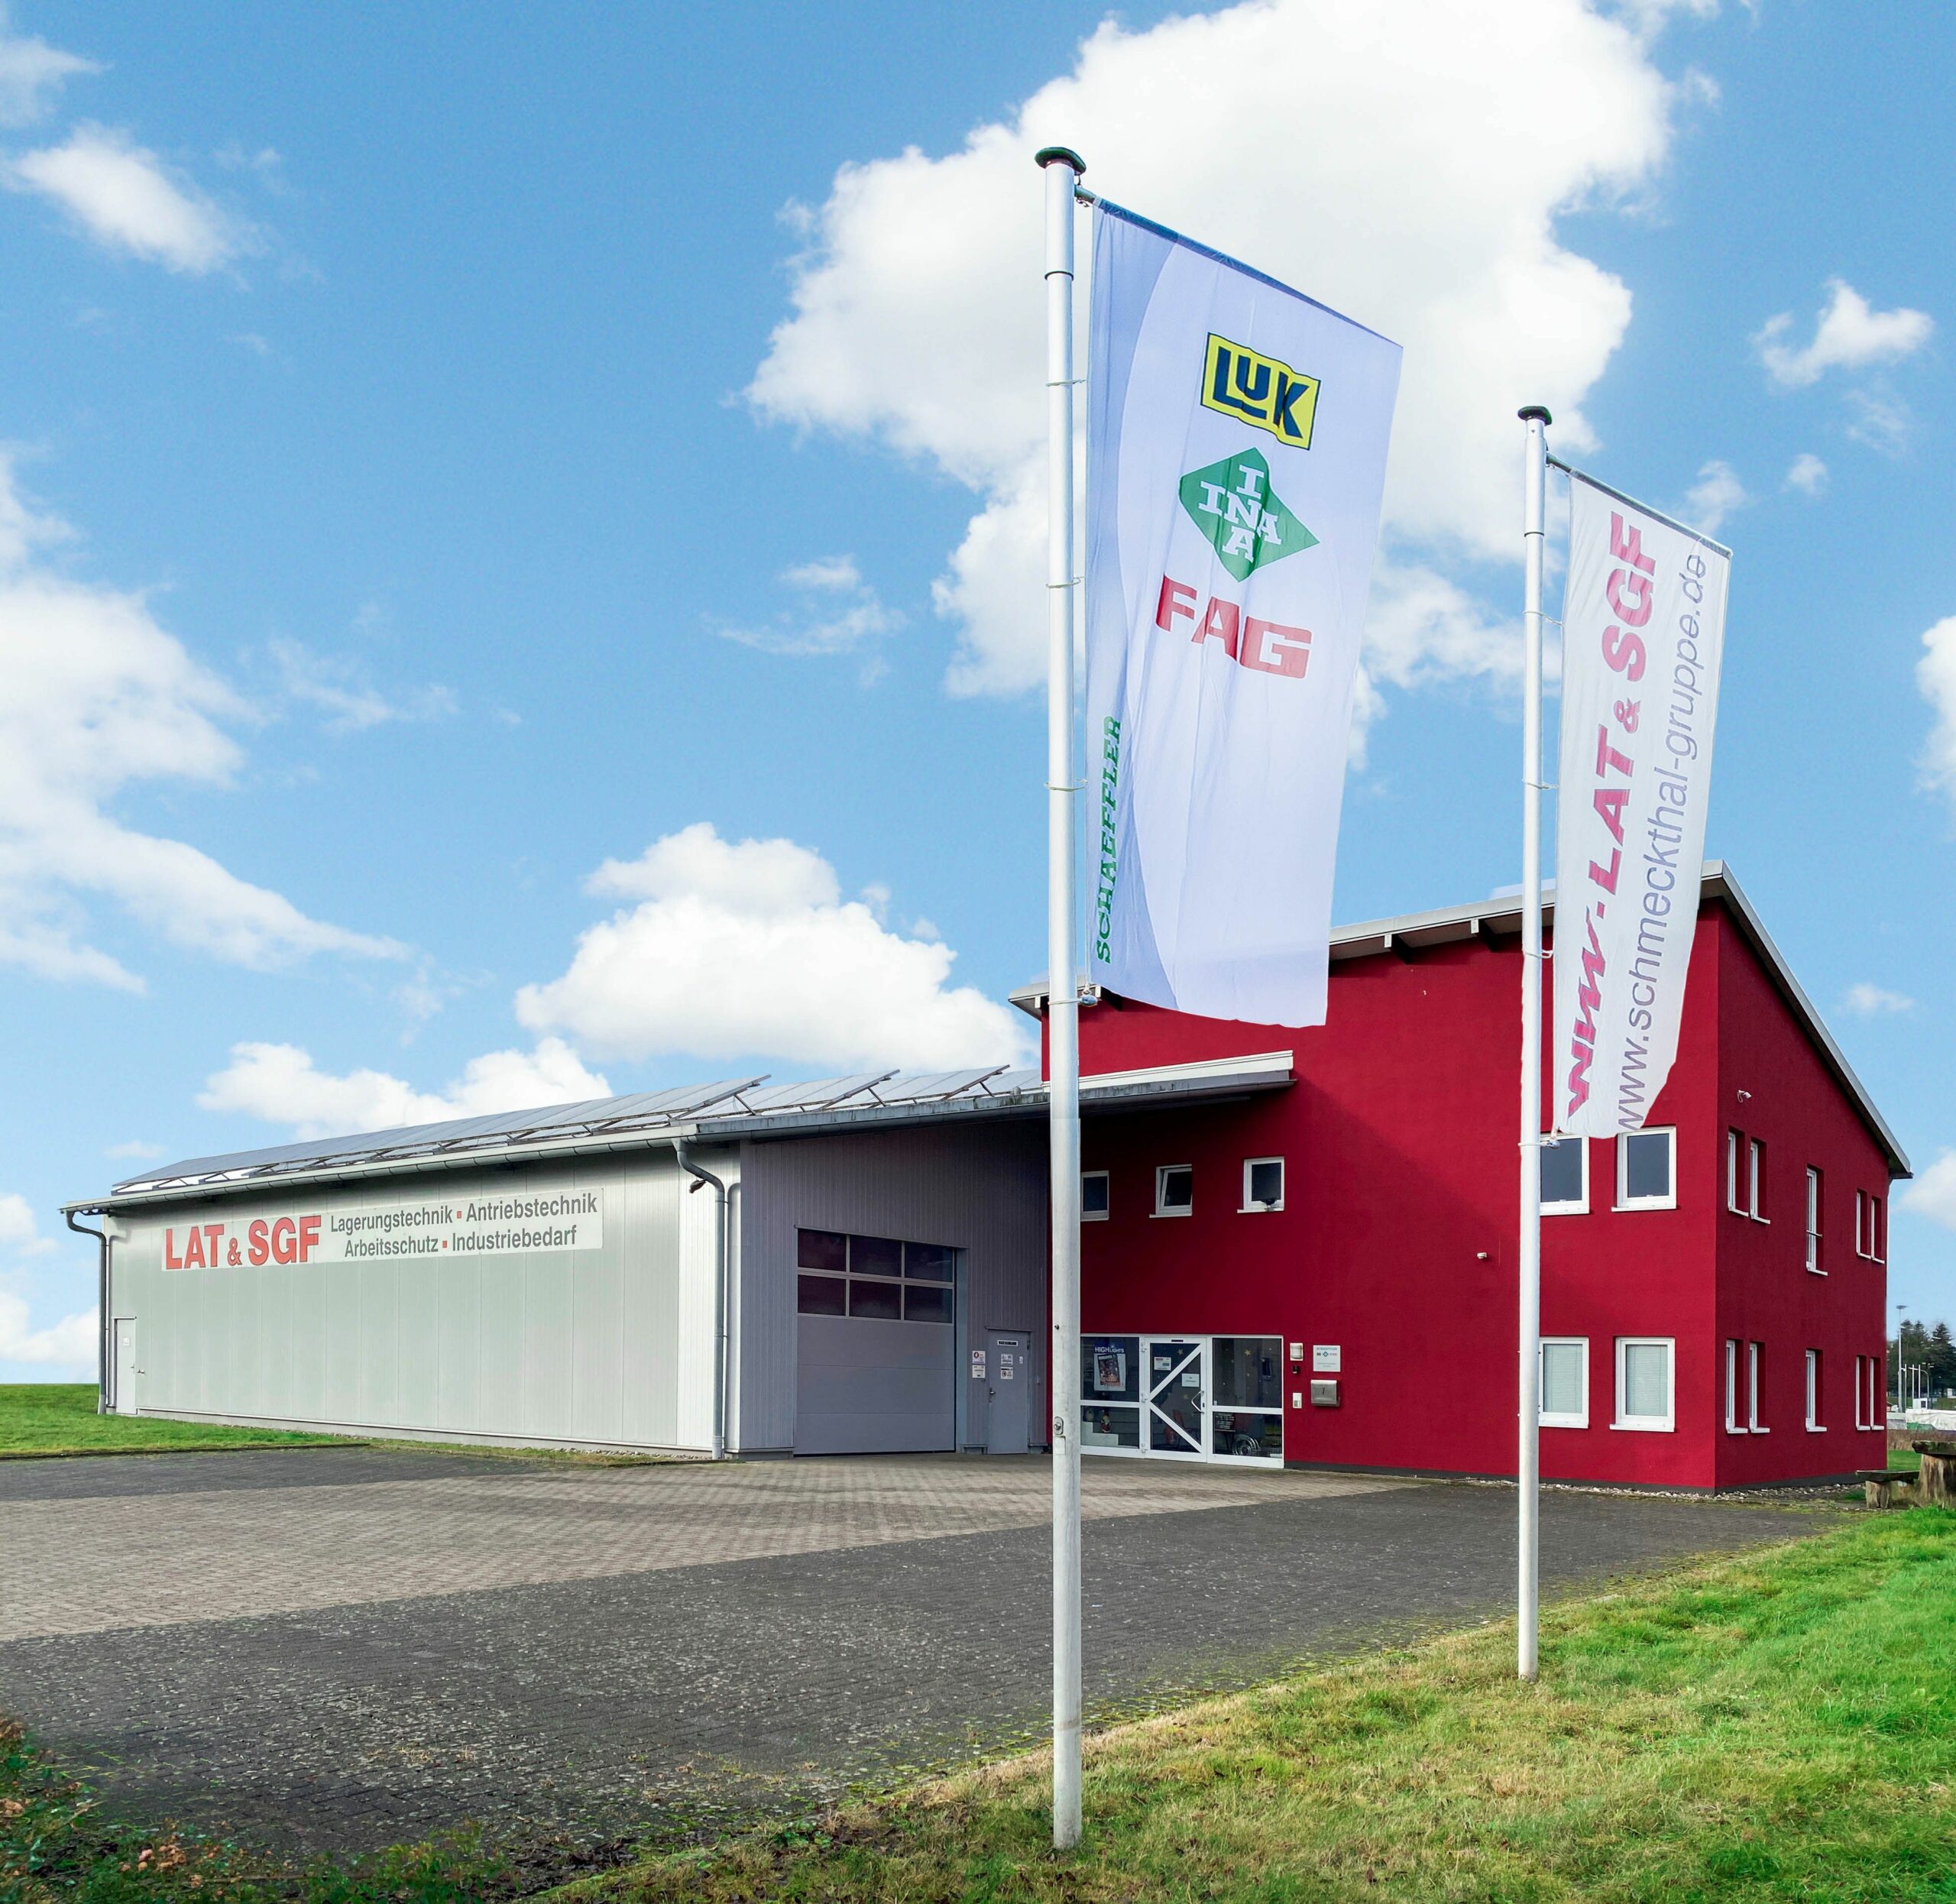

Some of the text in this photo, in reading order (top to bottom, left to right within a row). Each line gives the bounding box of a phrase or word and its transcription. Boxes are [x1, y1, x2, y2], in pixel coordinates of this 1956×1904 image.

[1155, 575, 1312, 678] FAG
[1588, 511, 1656, 895] LAT & SGF
[1096, 716, 1122, 964] SCHAEFFLER
[1618, 554, 1707, 1131] www.schmeckthal-gruppe.de
[166, 1215, 322, 1270] LAT & SGF
[331, 1193, 597, 1235] Lagerungstechnik Antriebstechnik
[345, 1225, 577, 1258] Arbeitsschutz Industriebedarf
